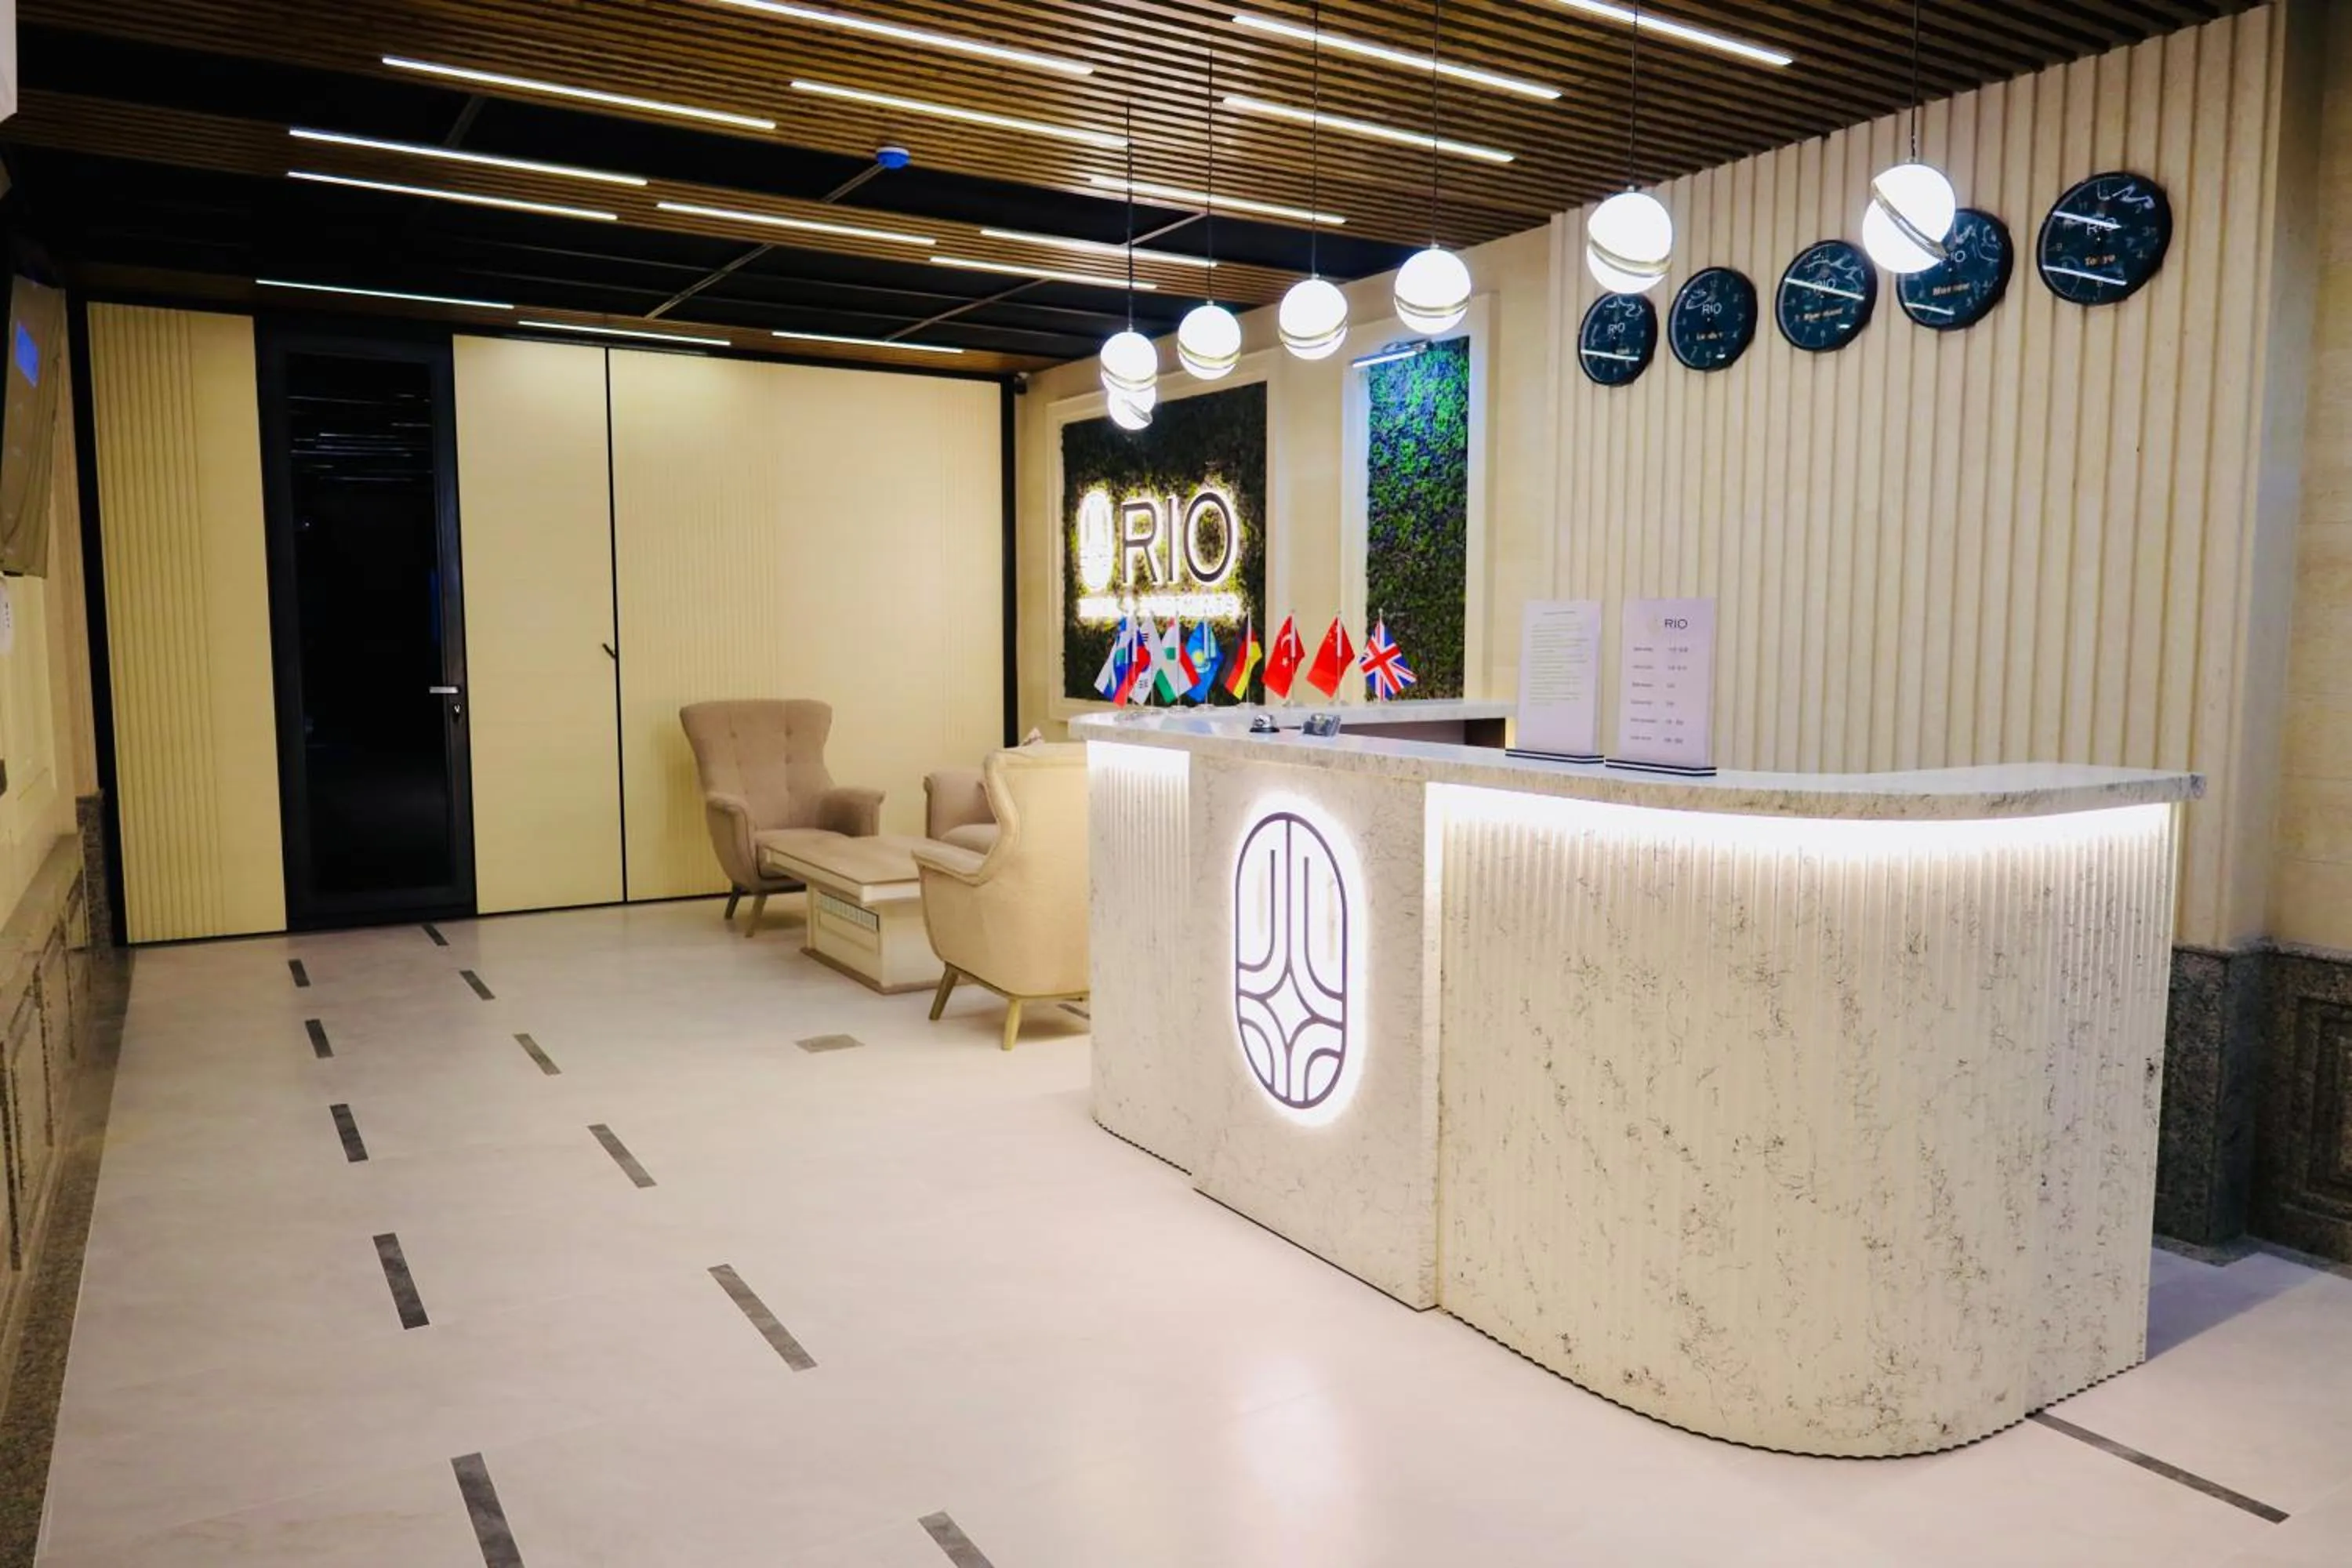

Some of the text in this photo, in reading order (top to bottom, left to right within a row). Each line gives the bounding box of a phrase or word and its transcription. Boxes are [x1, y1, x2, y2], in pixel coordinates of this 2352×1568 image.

[1701, 301, 1723, 315] RIO
[1122, 492, 1232, 583] RIO
[1664, 618, 1689, 630] RIO
